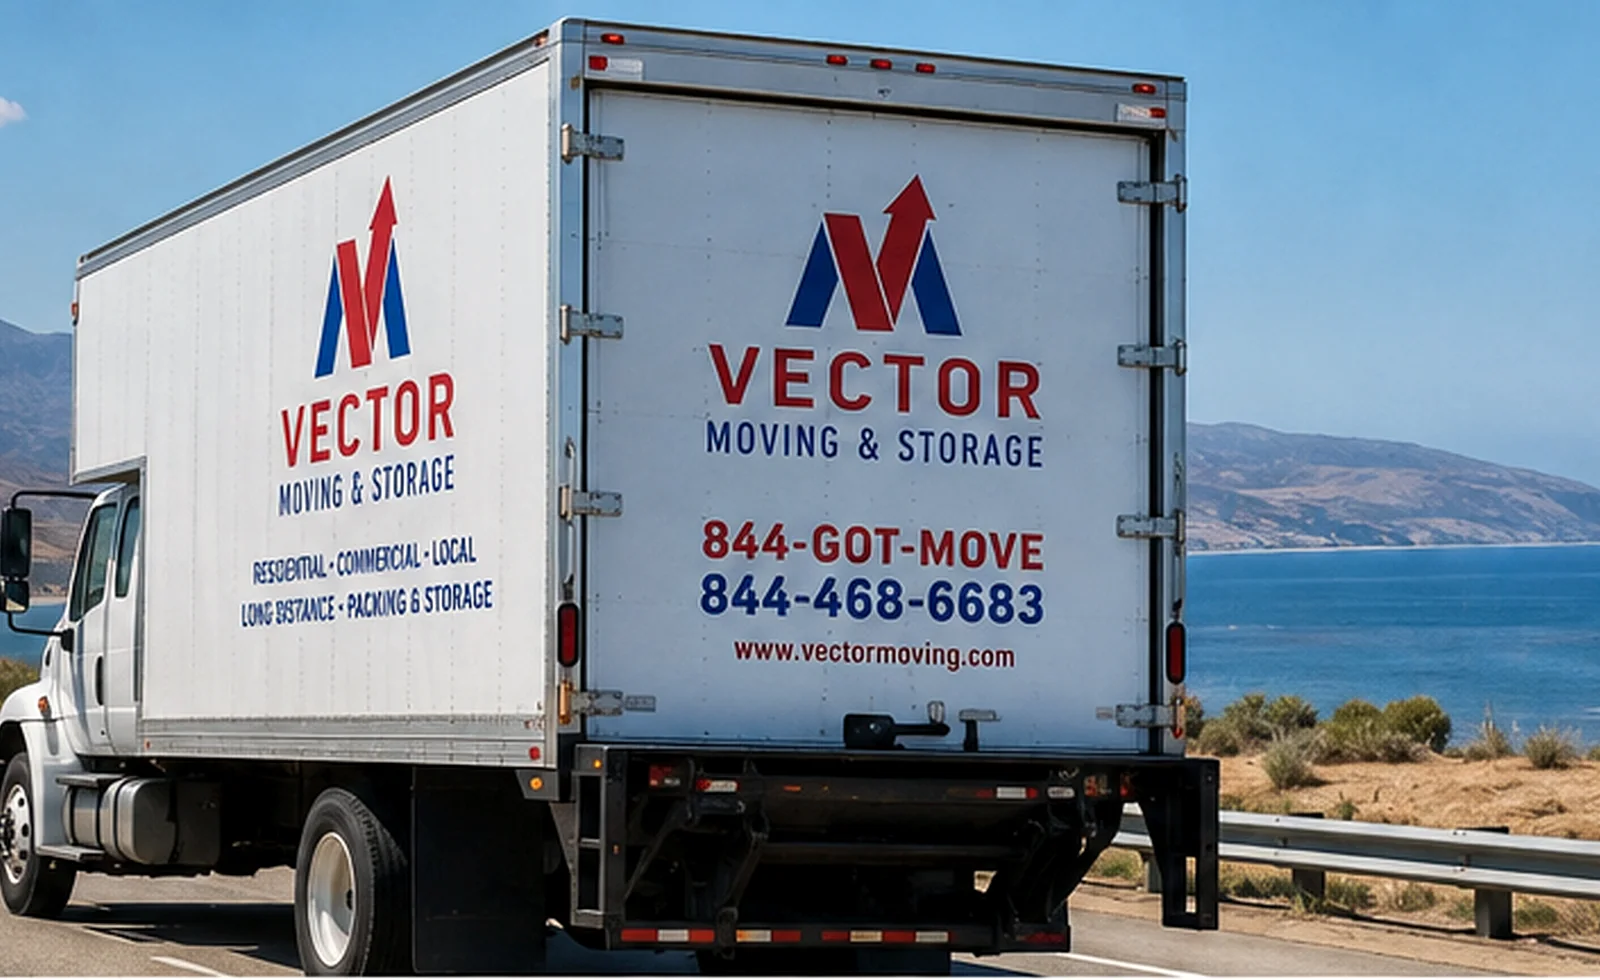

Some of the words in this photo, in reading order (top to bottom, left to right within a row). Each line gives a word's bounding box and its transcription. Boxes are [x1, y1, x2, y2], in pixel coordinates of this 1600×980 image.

[709, 343, 1041, 420] VECTOR
[281, 372, 455, 468] VECTOR
[706, 420, 838, 458] MOVING
[859, 427, 879, 461] &
[898, 430, 1043, 468] STORAGE
[278, 473, 343, 517] MOVING
[351, 471, 364, 505] &
[372, 454, 455, 502] STORAGE
[432, 536, 476, 566] LOCAL
[702, 519, 1044, 571] 844-GOT-MOVE
[424, 580, 493, 613] STORAGE
[700, 573, 1044, 625] 844-468-6683
[734, 641, 1015, 672] www.vectormoving.com
